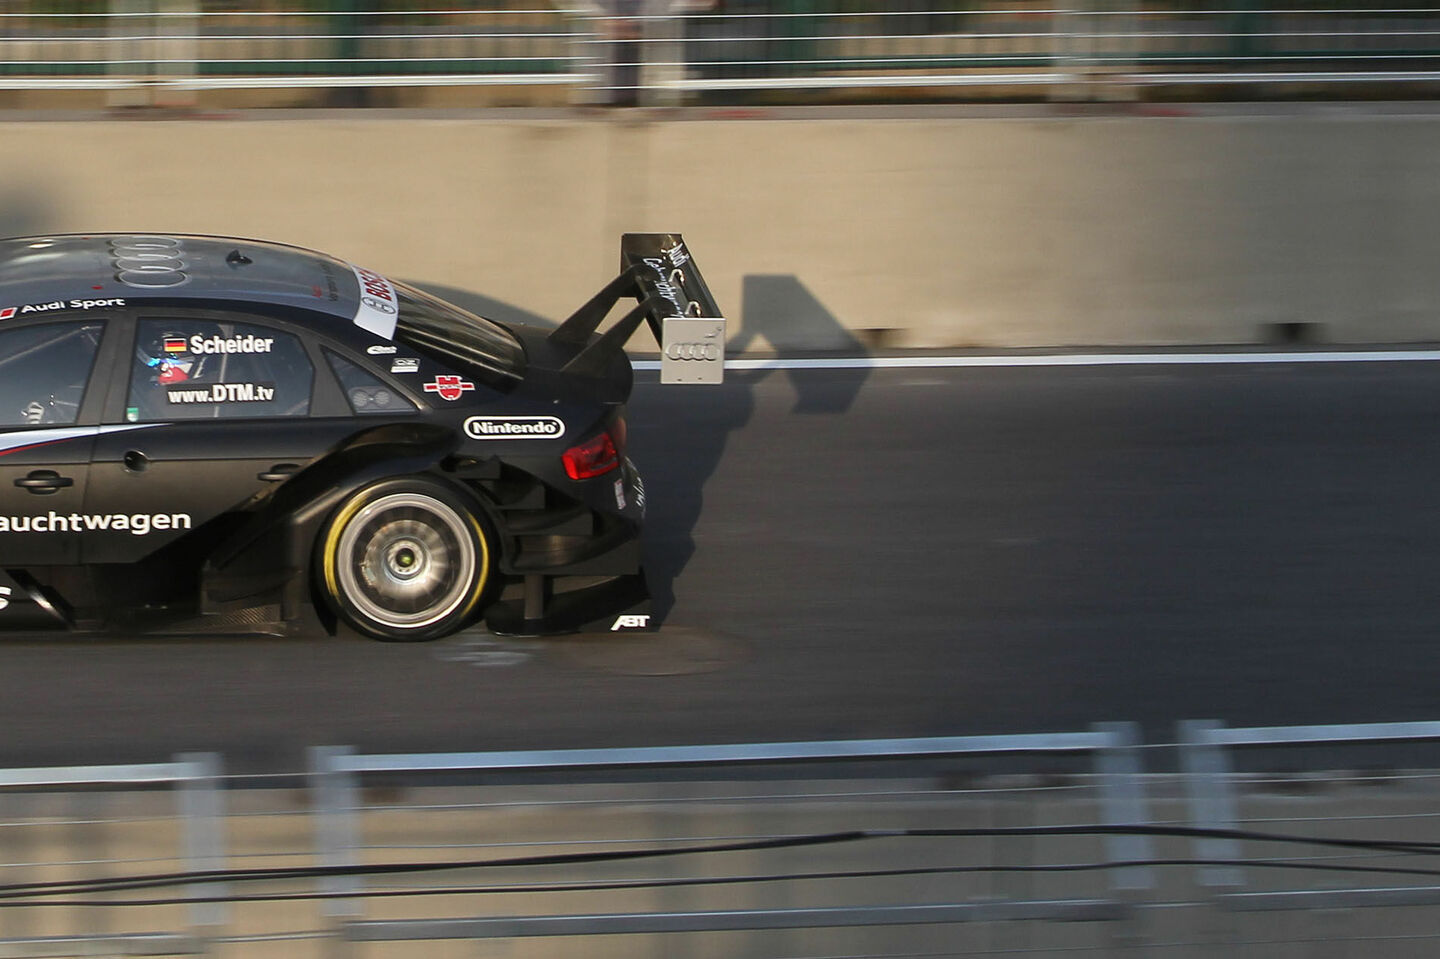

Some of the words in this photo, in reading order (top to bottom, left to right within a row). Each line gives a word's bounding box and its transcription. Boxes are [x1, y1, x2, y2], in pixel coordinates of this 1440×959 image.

[21, 302, 65, 314] Audi
[70, 297, 126, 310] Sport
[190, 334, 274, 355] Scheider
[167, 383, 275, 404] www.DTM.tv
[472, 421, 557, 434] Nintendo
[610, 615, 651, 631] ABT
